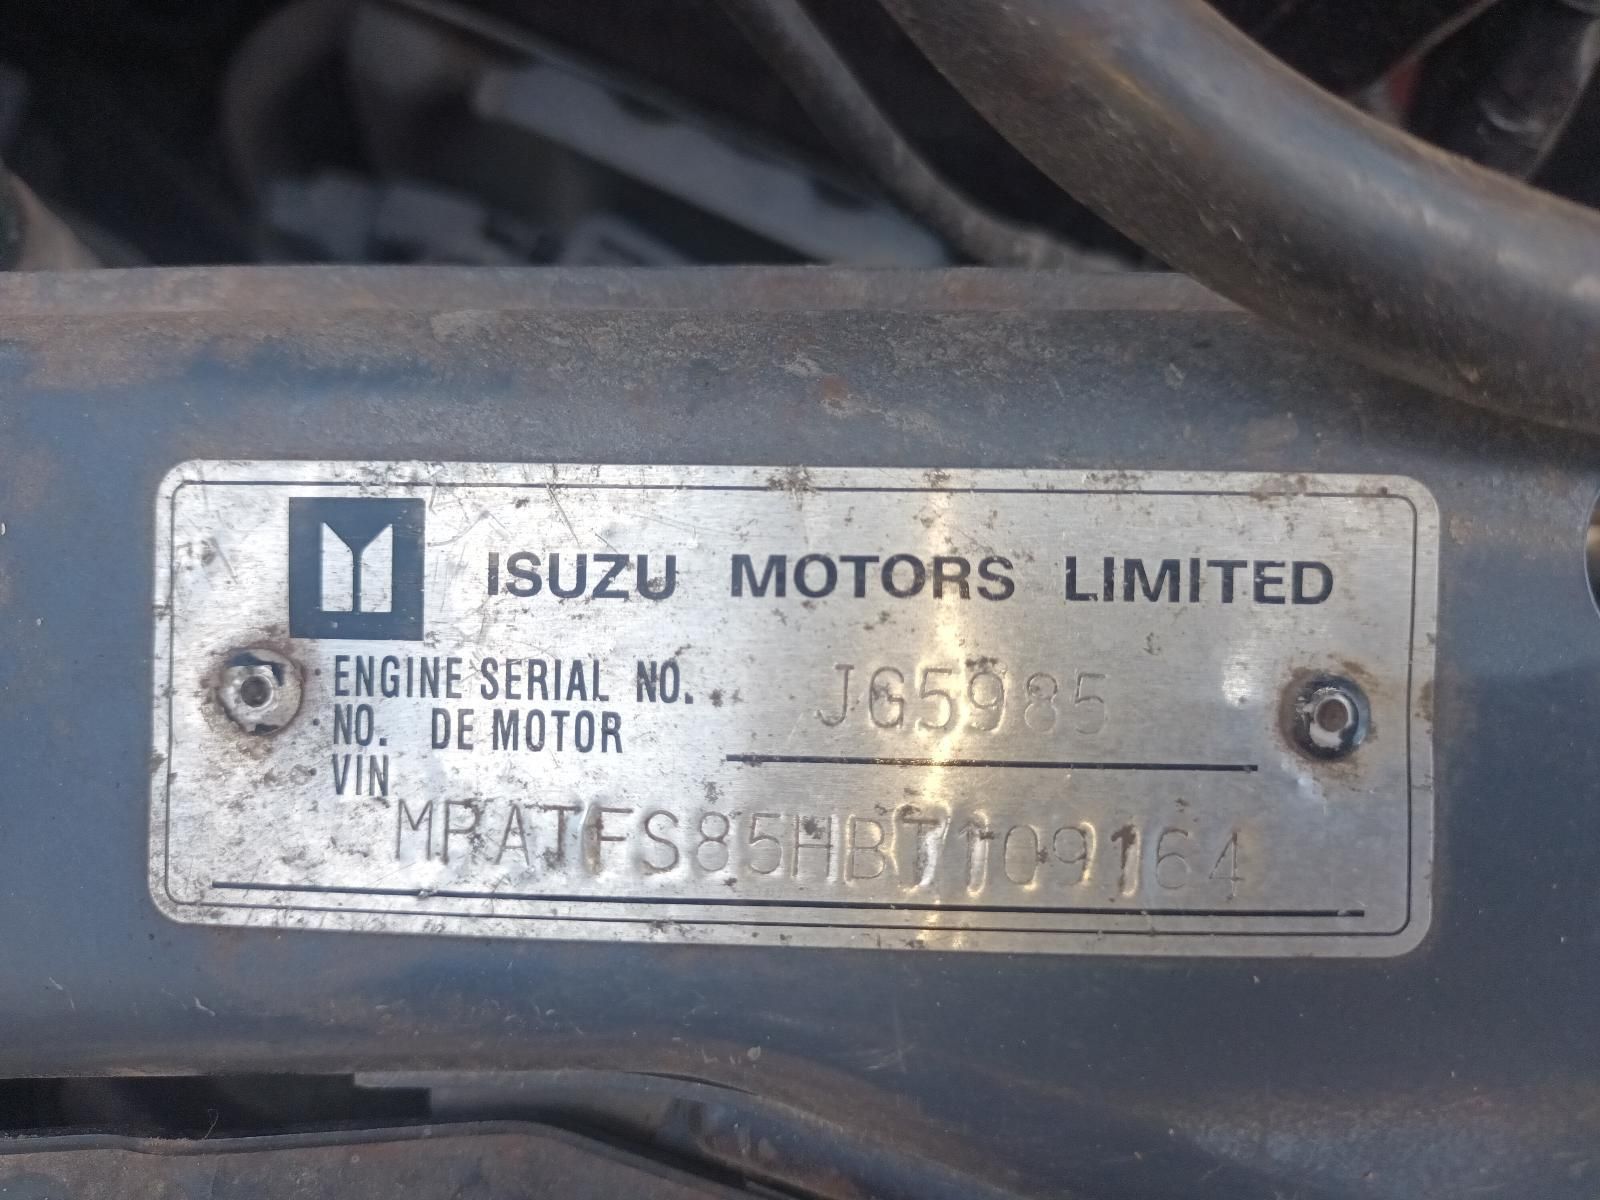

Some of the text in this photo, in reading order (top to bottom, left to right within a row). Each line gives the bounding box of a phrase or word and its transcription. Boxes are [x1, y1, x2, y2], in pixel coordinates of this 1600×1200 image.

[487, 551, 1334, 604] ISUZU MOTORS LIMITED
[334, 655, 694, 704] ENGINE SERIAL NO.
[814, 662, 1109, 735] JG5985
[333, 704, 623, 753] NO. DE MOTOR
[333, 753, 389, 797] VIN
